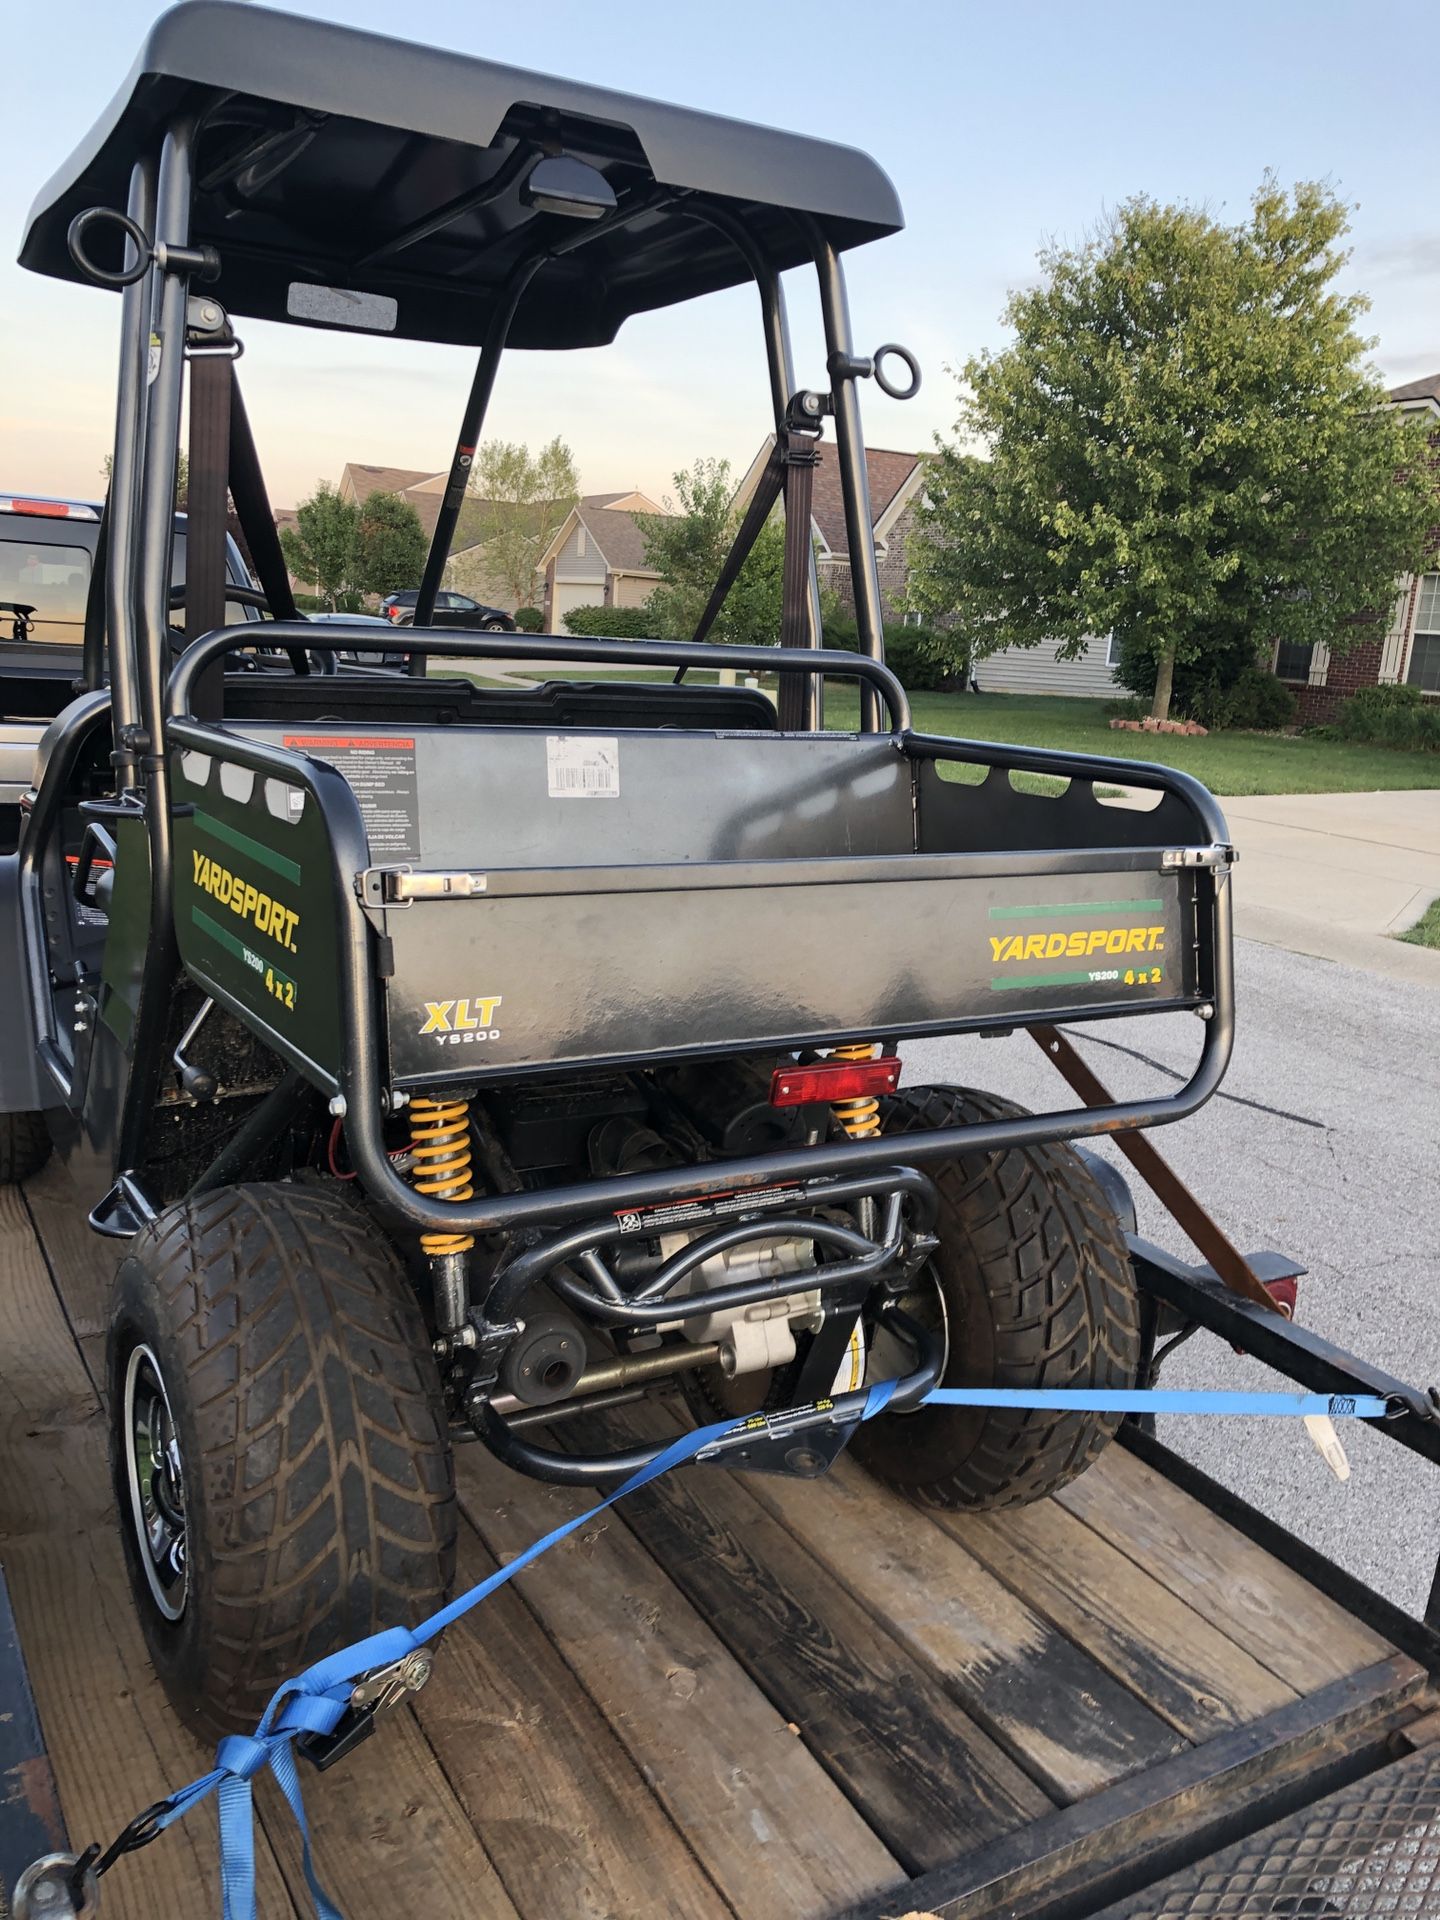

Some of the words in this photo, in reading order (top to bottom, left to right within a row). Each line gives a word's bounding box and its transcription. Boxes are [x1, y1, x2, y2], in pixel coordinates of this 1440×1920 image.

[989, 926, 1165, 962] YARDSPORT
[242, 947, 264, 974] YS200
[1088, 969, 1119, 981] YS200
[418, 995, 503, 1034] XLT
[435, 1029, 501, 1046] YS200
